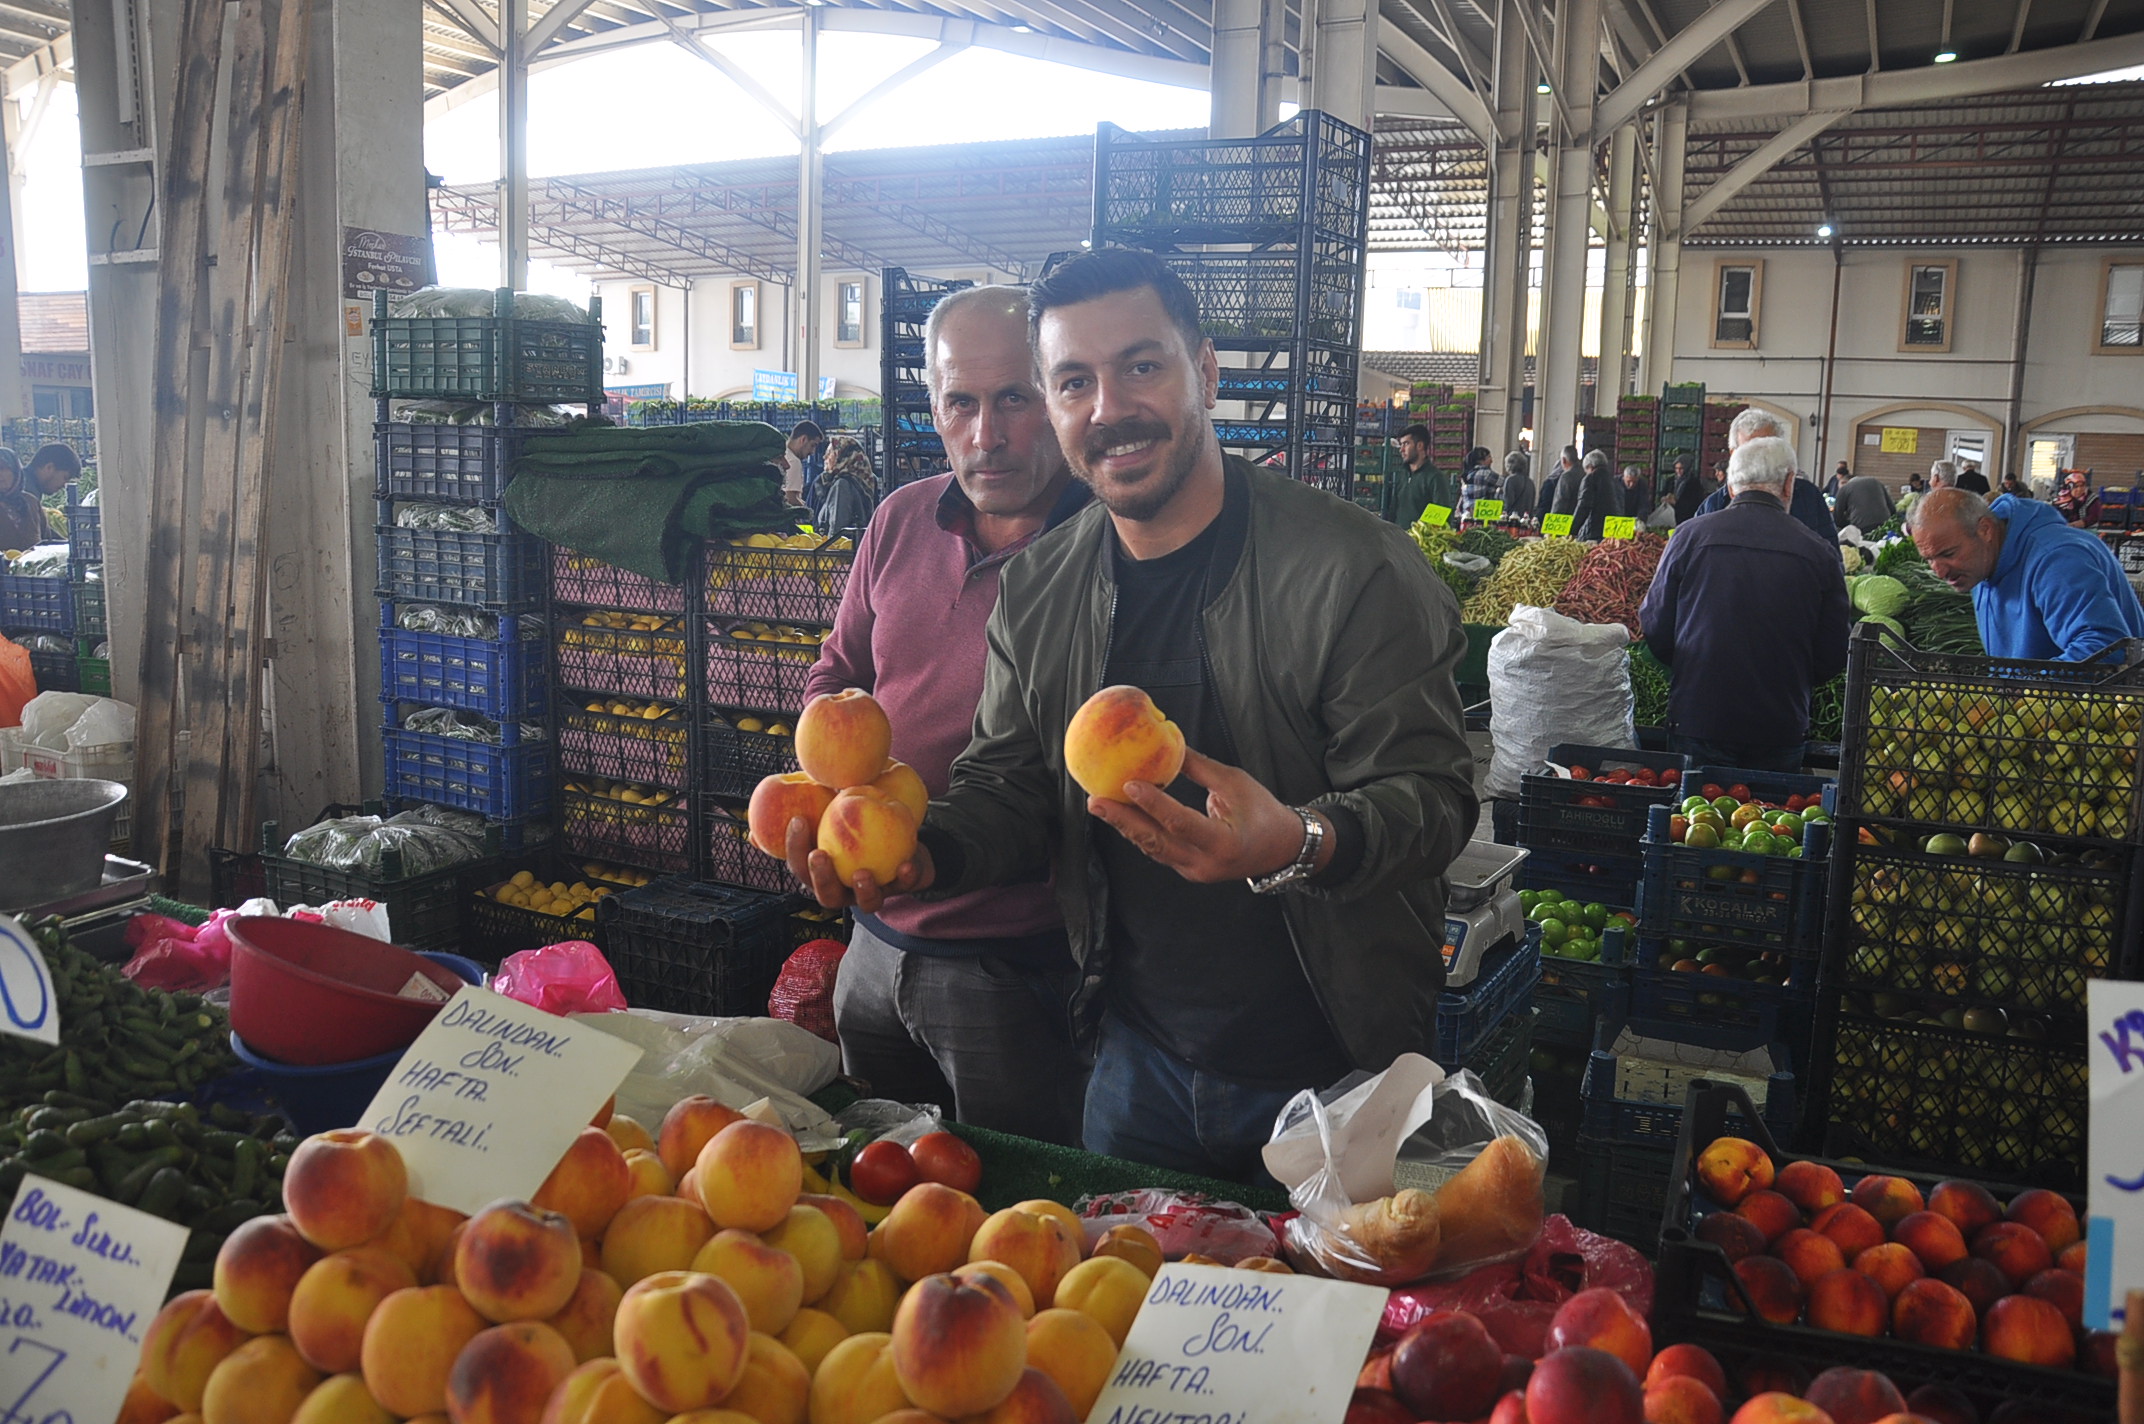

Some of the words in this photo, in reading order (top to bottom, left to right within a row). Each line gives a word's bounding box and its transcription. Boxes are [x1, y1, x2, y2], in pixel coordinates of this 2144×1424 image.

[386, 264, 403, 273] USTA
[57, 362, 84, 382] ÇAY
[1695, 897, 1777, 918] KOCALAR
